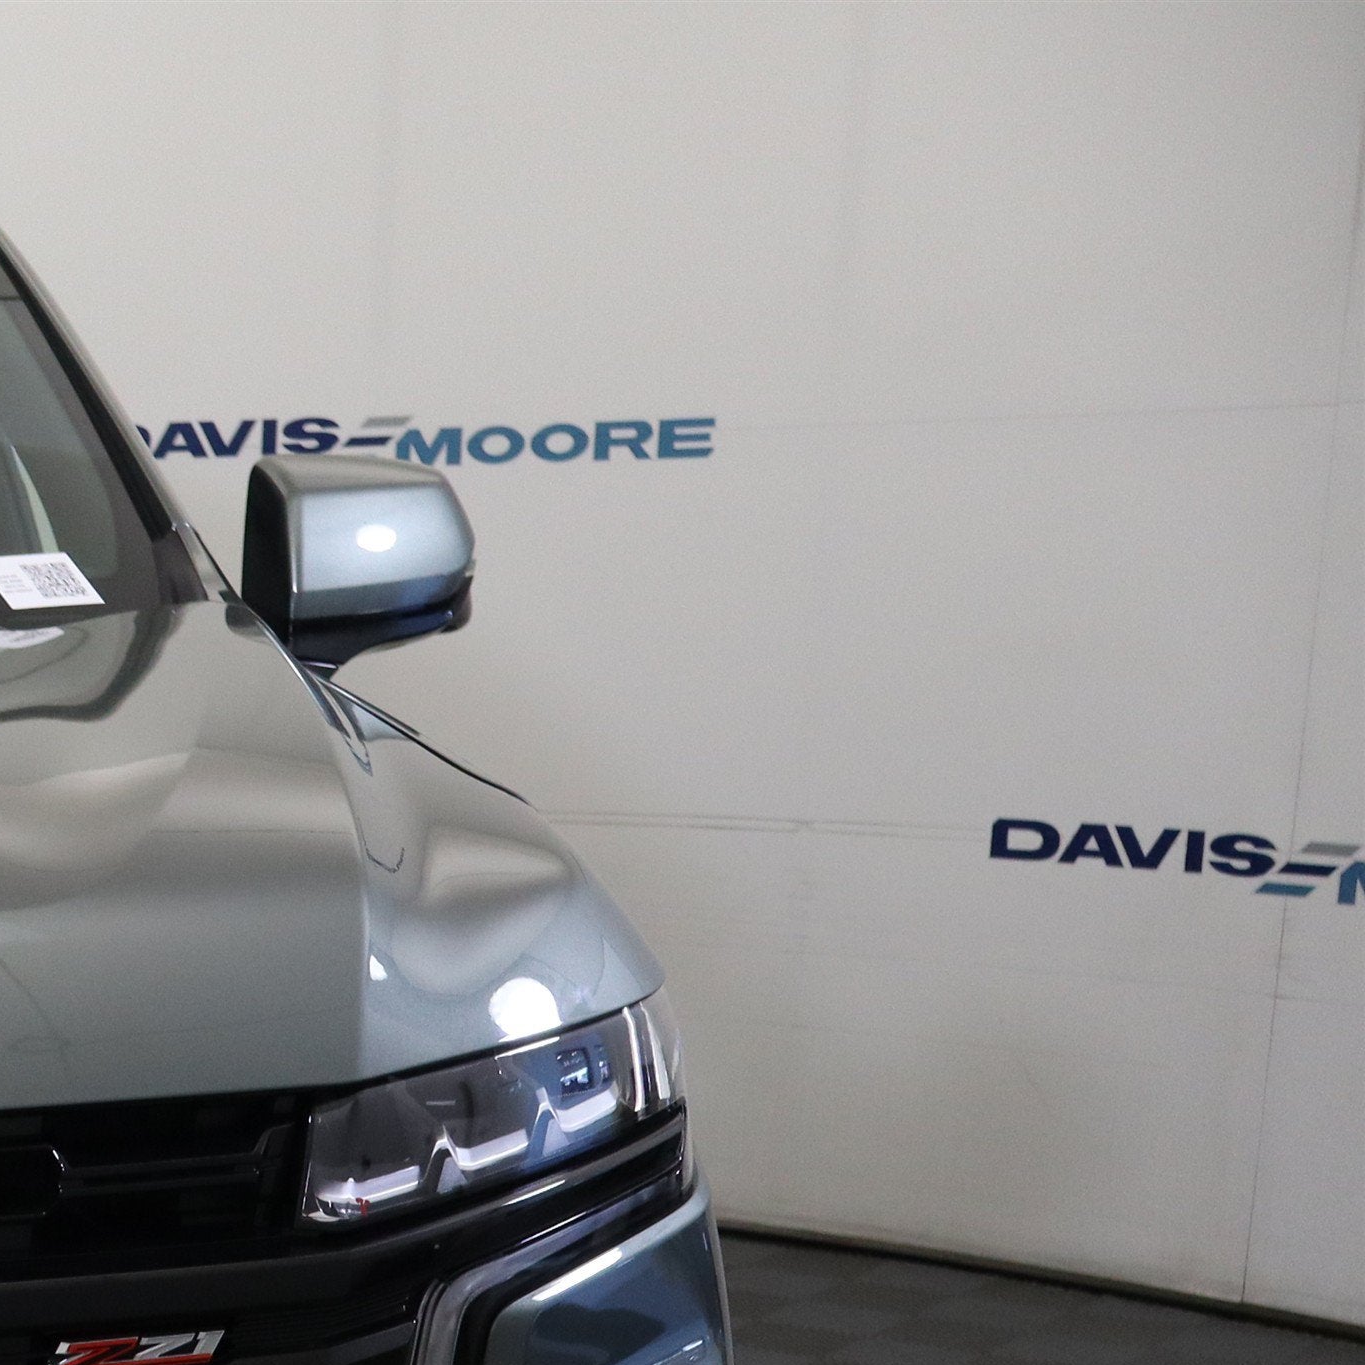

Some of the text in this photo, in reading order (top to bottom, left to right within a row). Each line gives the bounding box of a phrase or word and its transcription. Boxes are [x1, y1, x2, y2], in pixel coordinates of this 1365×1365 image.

[136, 417, 715, 465] AVIS MOORE
[990, 818, 1277, 878] DAVIS
